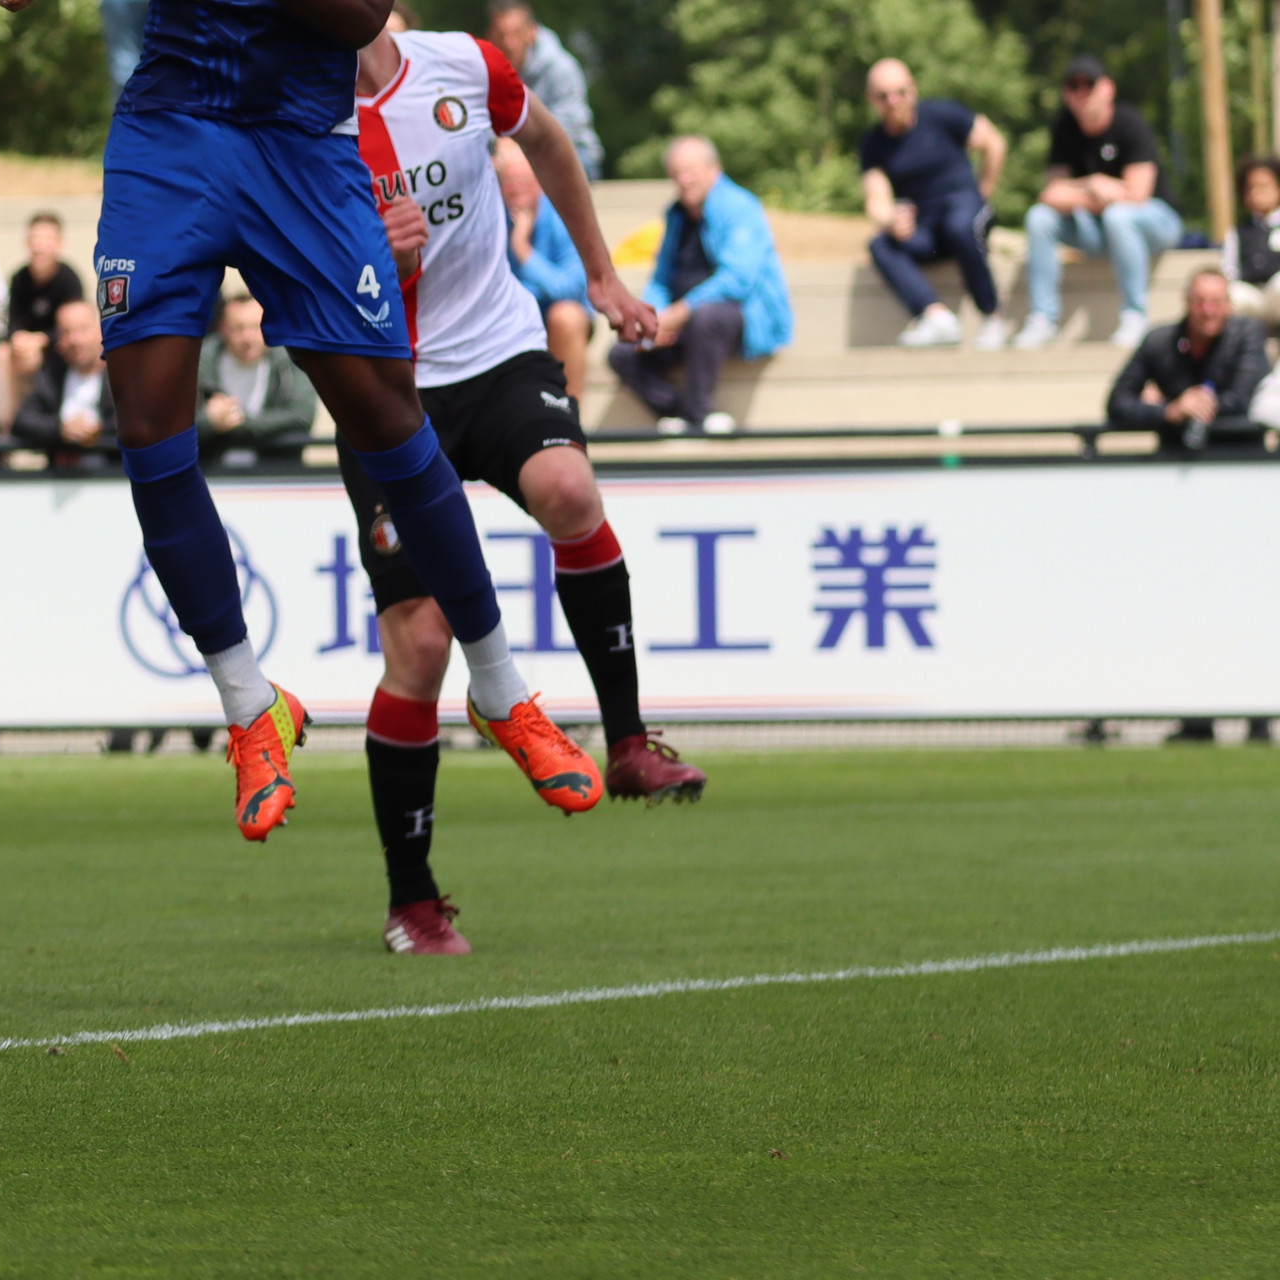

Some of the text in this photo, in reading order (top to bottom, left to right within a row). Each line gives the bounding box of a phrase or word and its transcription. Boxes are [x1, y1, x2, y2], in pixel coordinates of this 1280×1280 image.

[370, 161, 447, 207] uro
[104, 258, 136, 272] DFDS
[356, 264, 381, 299] 4
